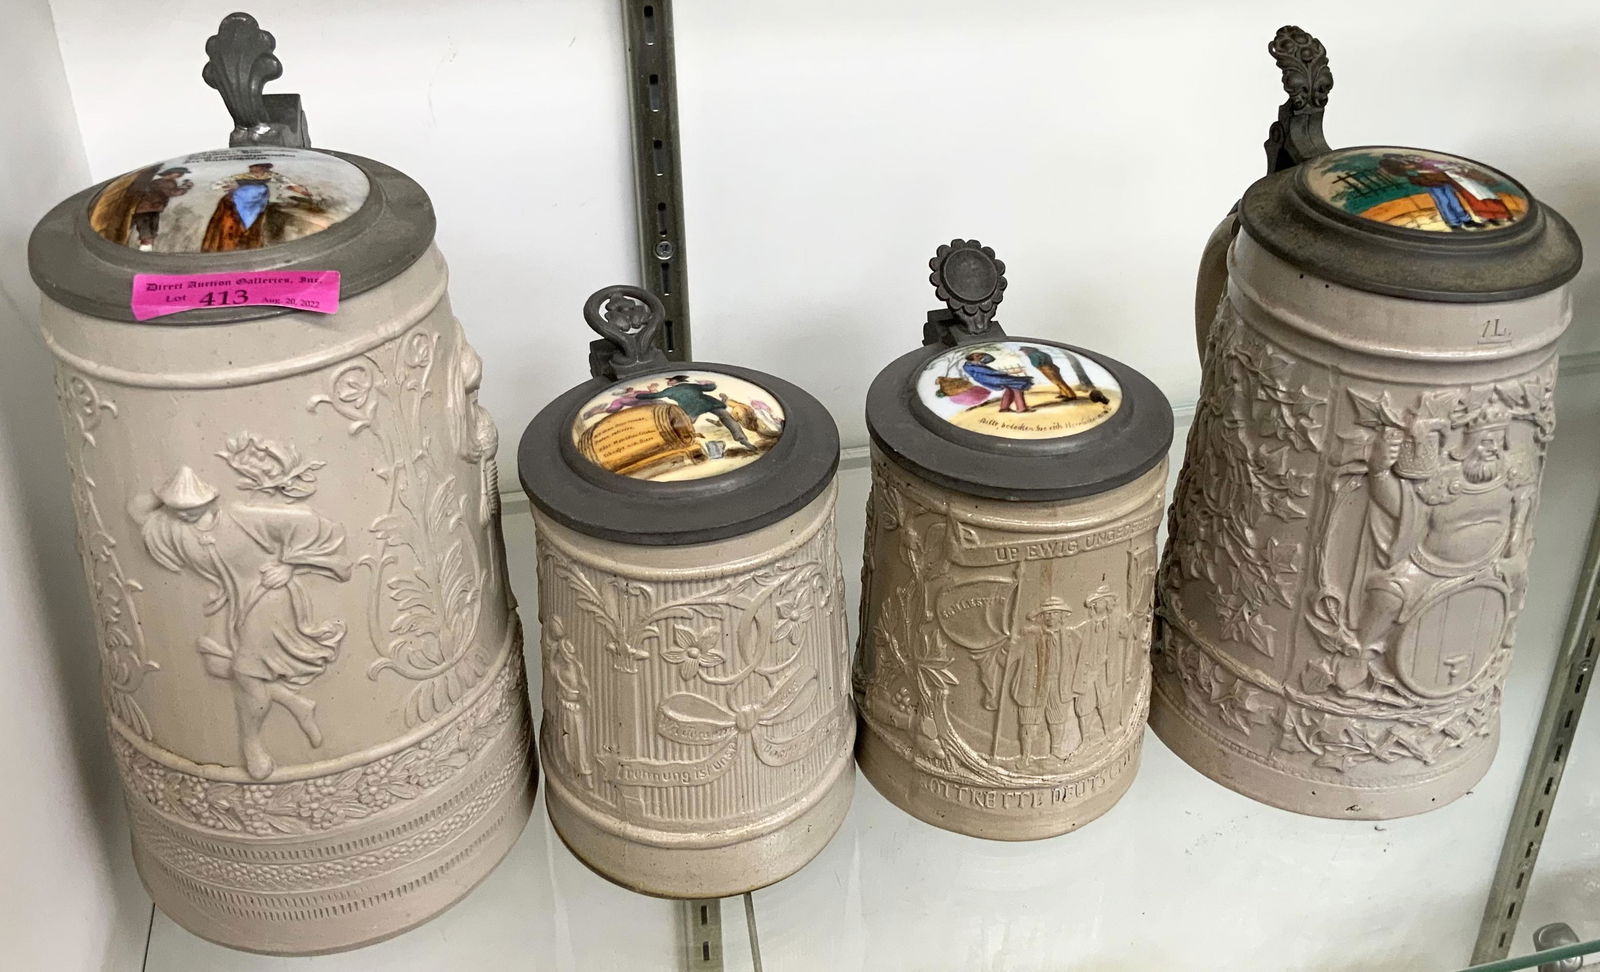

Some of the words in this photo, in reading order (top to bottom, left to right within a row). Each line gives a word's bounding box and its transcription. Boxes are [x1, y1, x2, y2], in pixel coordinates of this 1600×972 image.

[146, 282, 184, 292] Direct
[187, 279, 232, 289] Auction
[165, 294, 188, 303] Lot
[198, 289, 250, 307] 413
[299, 299, 321, 309] 2022
[994, 546, 1019, 562] UP
[1025, 540, 1080, 560] EWIG
